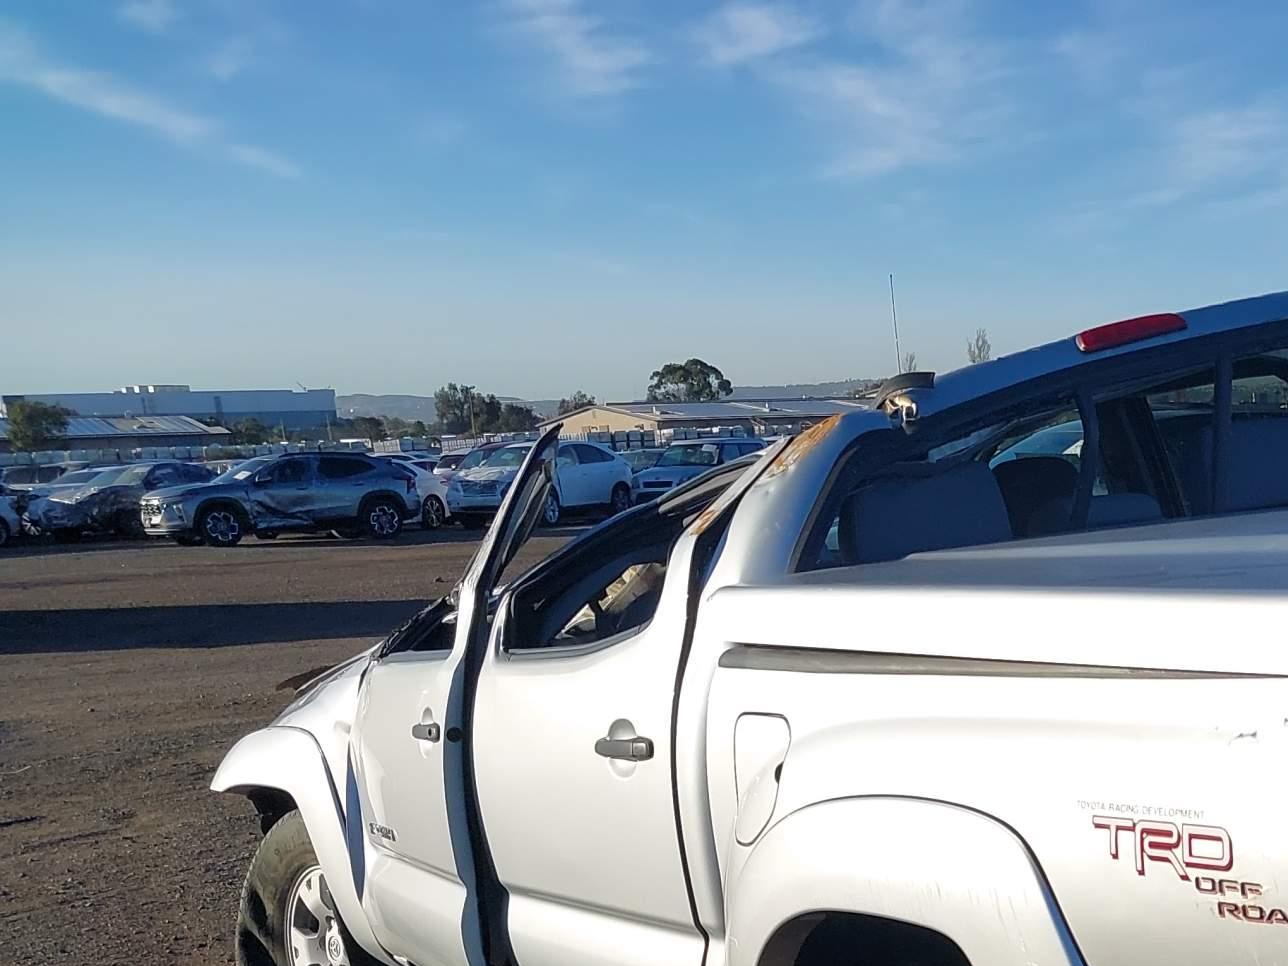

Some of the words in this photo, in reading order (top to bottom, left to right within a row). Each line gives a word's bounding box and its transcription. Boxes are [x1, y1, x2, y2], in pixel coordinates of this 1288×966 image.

[1077, 800, 1106, 811] TOYOTA
[1108, 803, 1139, 815] RACING
[1142, 805, 1205, 820] DEVELOPMENT
[1092, 815, 1233, 882] TRD
[1195, 876, 1263, 900] OFF
